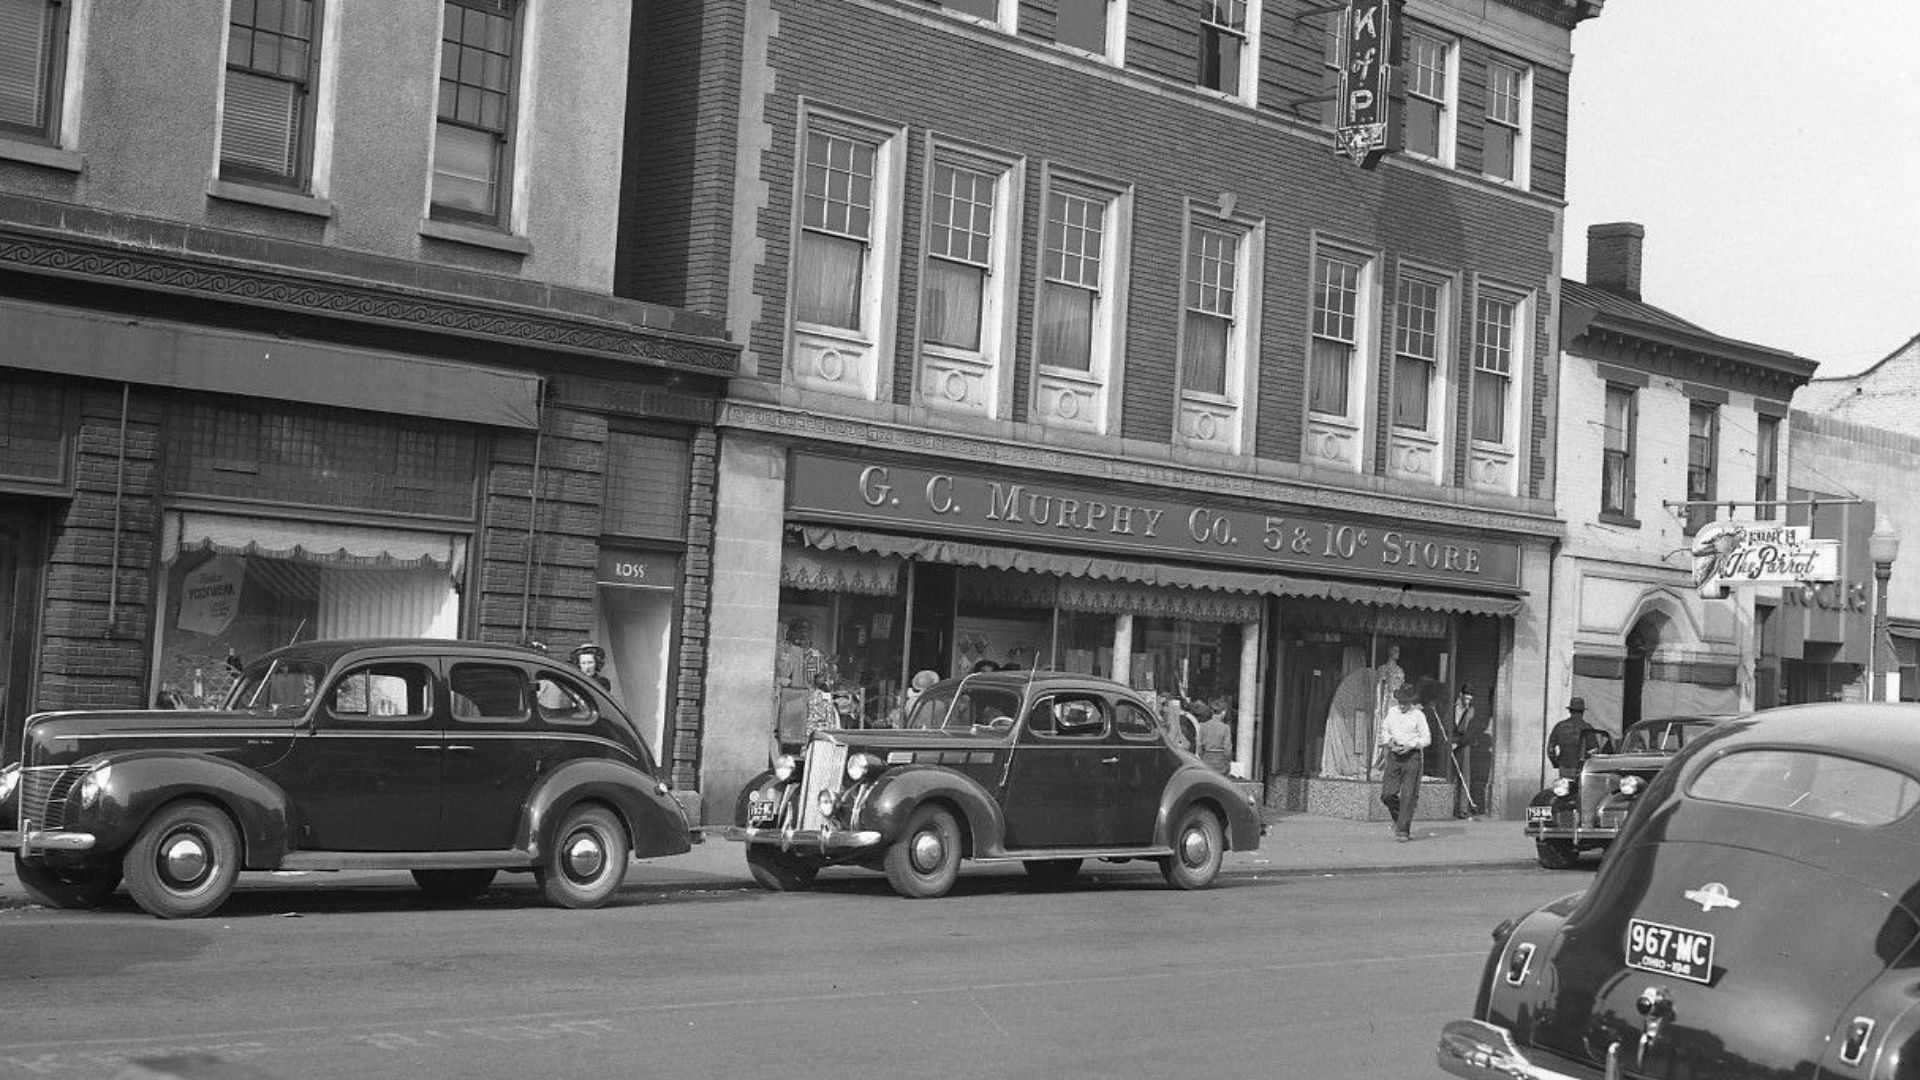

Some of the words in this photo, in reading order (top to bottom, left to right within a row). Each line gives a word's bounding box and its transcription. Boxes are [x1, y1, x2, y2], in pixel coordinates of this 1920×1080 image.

[1354, 6, 1377, 40] K
[860, 466, 899, 506] G.
[926, 475, 960, 514] C.
[986, 482, 1164, 537] MURPHY
[1263, 516, 1284, 550] 5
[1291, 527, 1312, 554] &
[1383, 532, 1481, 573] STORE
[1748, 546, 1820, 579] Parrot
[1632, 924, 1708, 965] 967-MC
